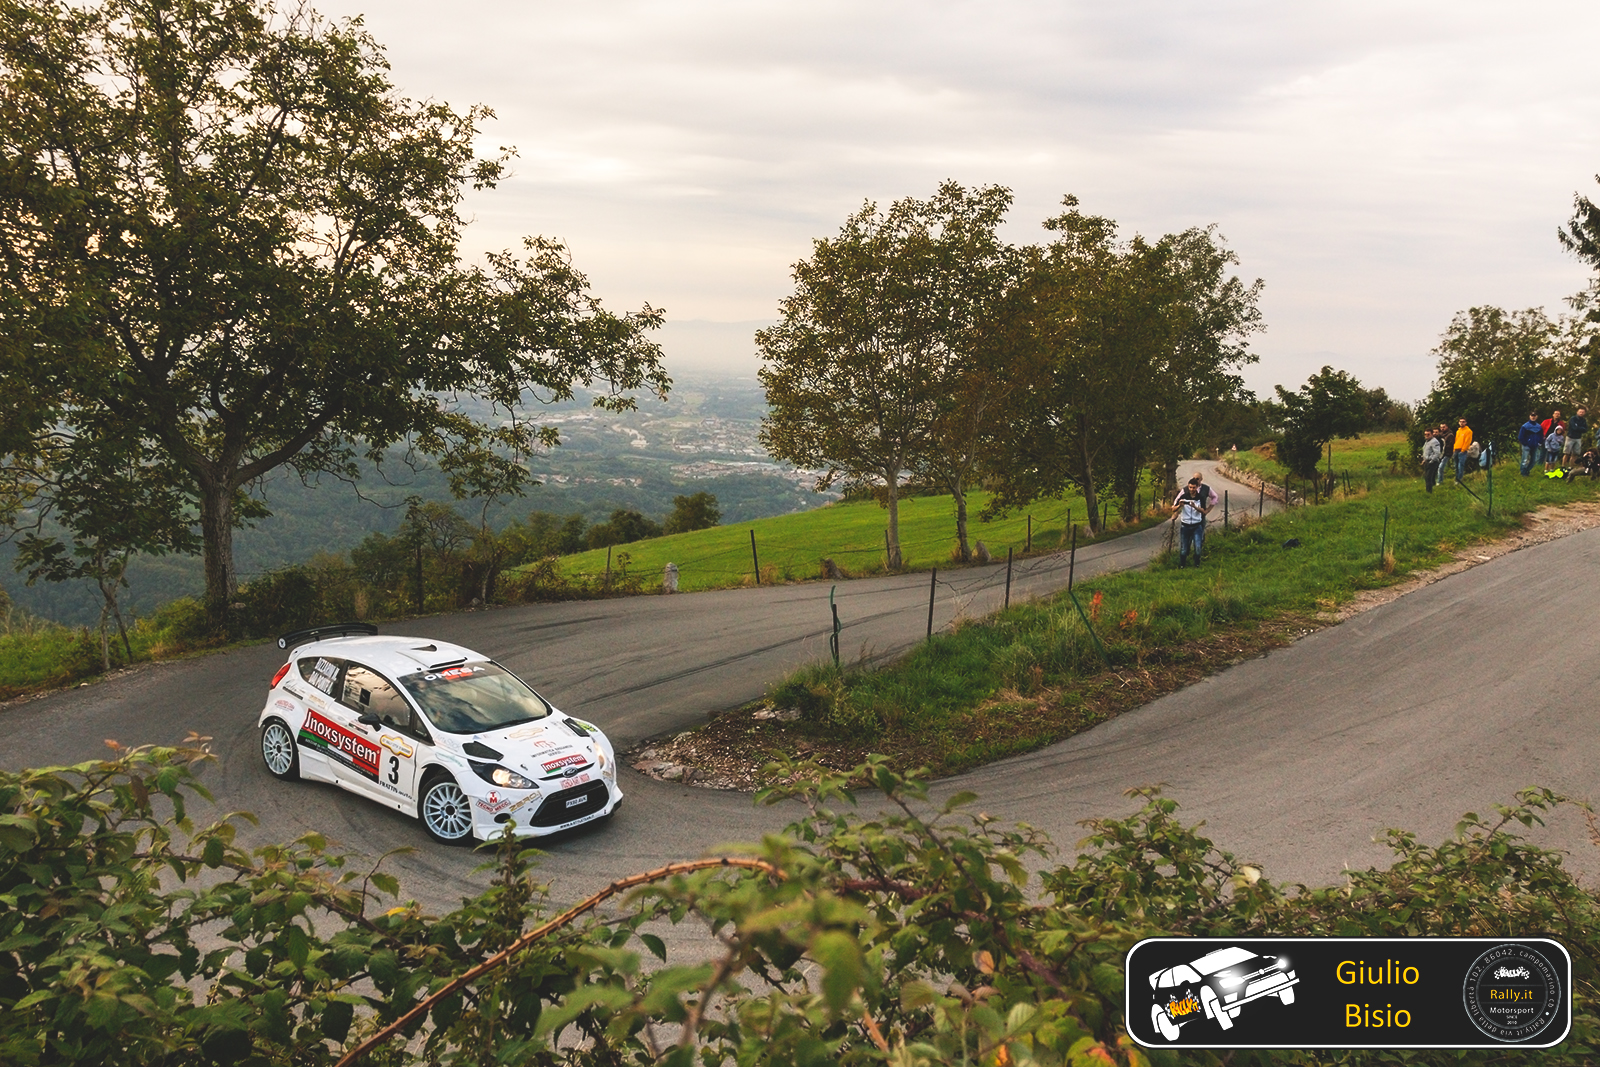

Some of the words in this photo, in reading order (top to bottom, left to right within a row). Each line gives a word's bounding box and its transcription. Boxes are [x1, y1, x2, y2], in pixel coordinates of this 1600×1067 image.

[304, 711, 377, 765] Inoxsystem
[387, 755, 400, 785] 3
[542, 755, 585, 771] Inoxsystem
